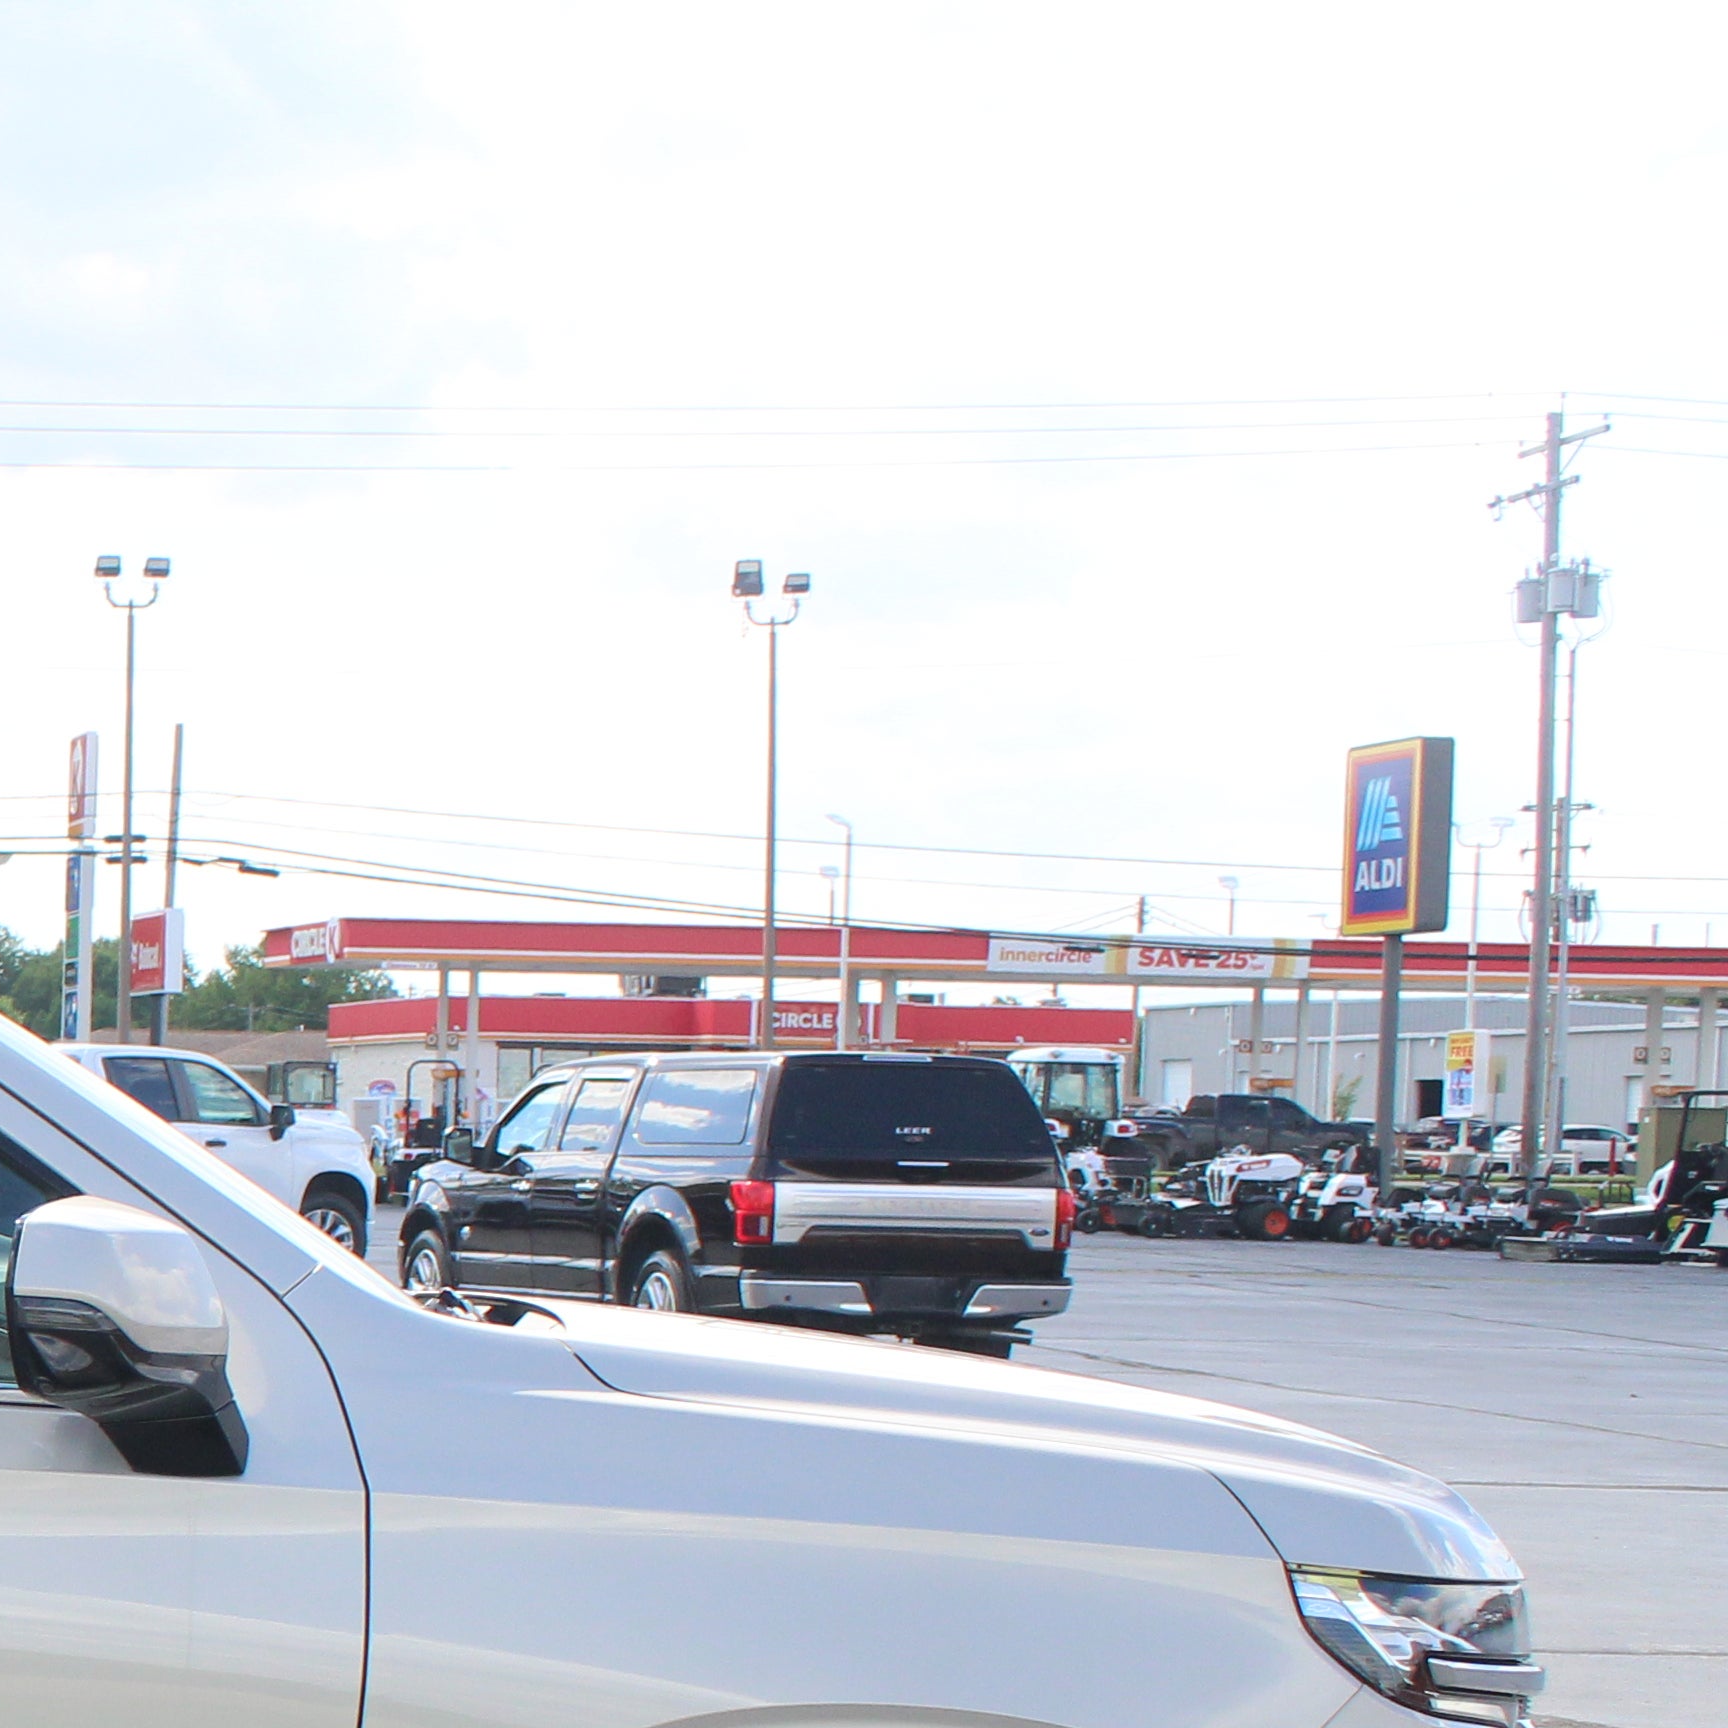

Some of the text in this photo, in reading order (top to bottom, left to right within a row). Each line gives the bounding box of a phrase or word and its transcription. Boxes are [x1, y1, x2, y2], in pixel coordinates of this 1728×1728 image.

[1355, 856, 1403, 892] ALDI
[292, 928, 327, 958] CIRCLE
[1138, 946, 1211, 968] SAVE
[1451, 1046, 1473, 1057] FREE
[895, 1126, 932, 1135] LEER
